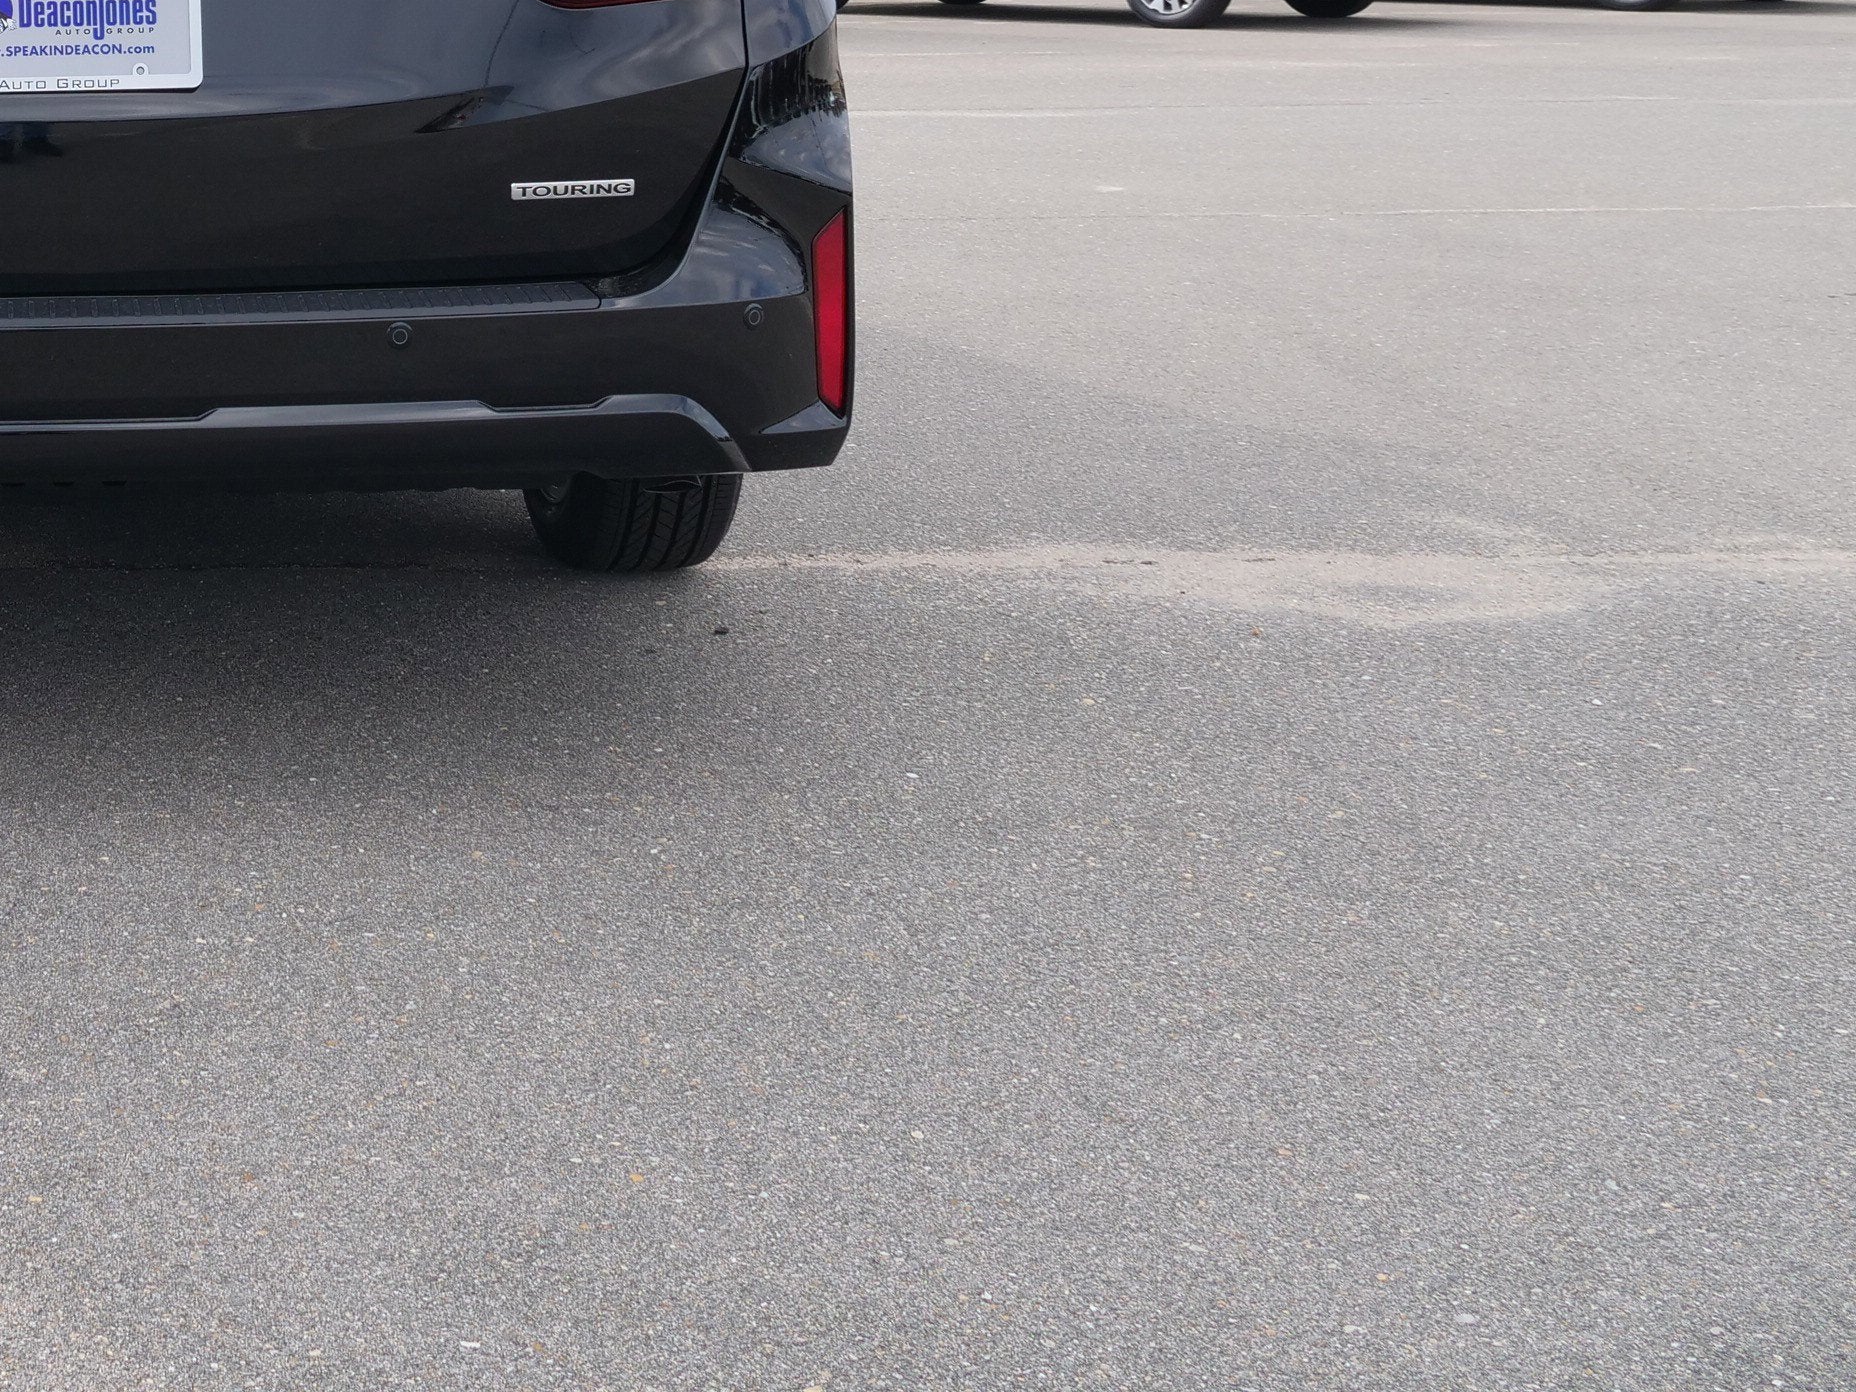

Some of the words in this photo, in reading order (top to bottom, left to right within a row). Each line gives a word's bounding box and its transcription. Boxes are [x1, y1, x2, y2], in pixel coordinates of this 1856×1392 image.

[55, 27, 91, 36] AUTO
[106, 26, 155, 35] GROUP
[56, 77, 120, 90] GROUP
[516, 182, 632, 197] TOURING
